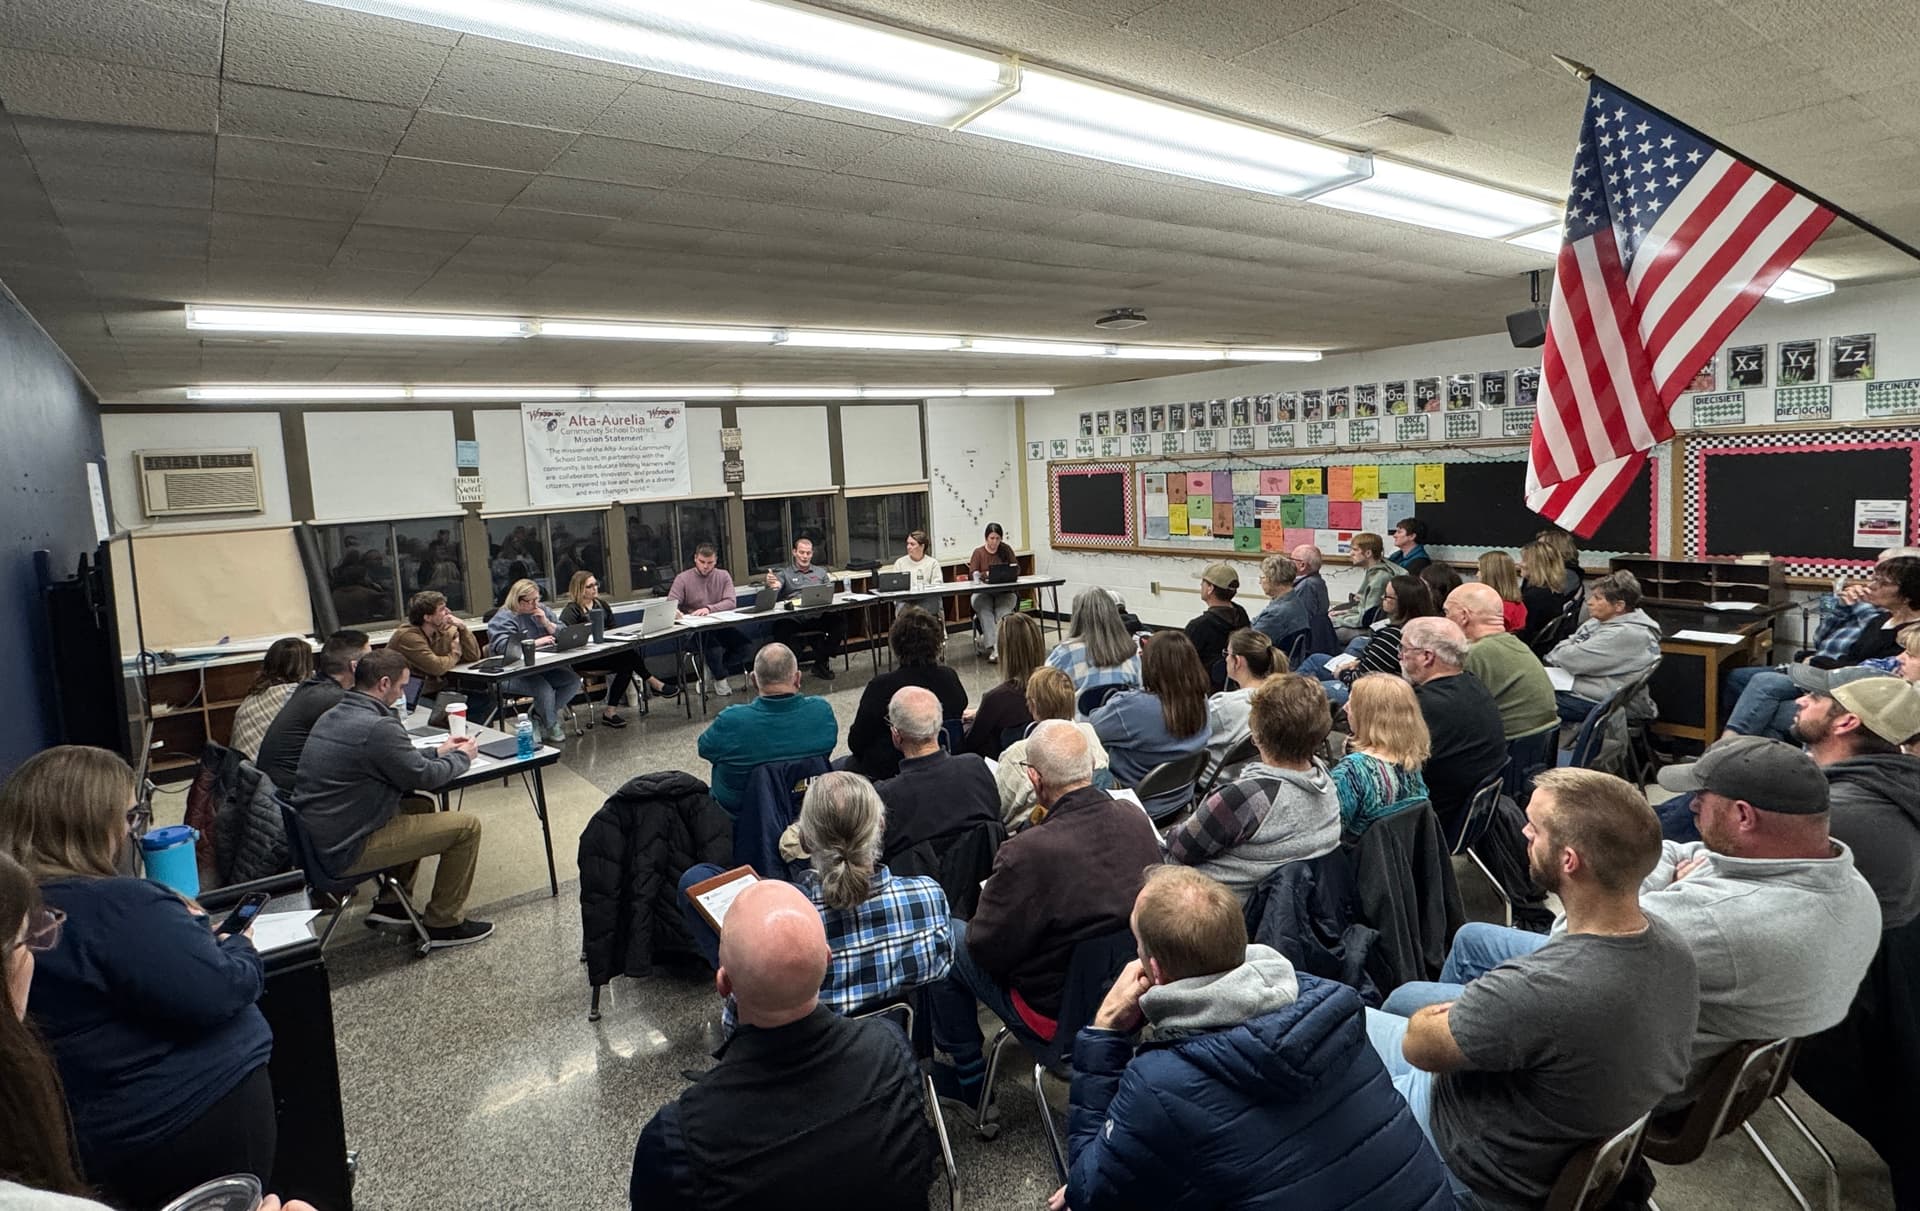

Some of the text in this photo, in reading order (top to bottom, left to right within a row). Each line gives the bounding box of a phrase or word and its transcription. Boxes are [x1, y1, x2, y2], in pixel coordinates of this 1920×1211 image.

[1786, 351, 1811, 369] Yy
[1839, 346, 1866, 363] Zz
[1736, 356, 1759, 372] Xx
[1486, 380, 1502, 393] Rr
[1521, 377, 1538, 390] Ss
[1869, 381, 1920, 391] DIECINUEV
[1387, 390, 1403, 401] Oo
[1419, 386, 1434, 401] Pp
[1452, 384, 1471, 397] Qq
[1328, 393, 1348, 407] Mm
[1696, 394, 1741, 405] DIECISIETE
[1172, 409, 1182, 420] Ff
[1777, 405, 1829, 416] DIECIOCHO
[569, 414, 645, 427] Alta-Aurelia
[1506, 422, 1533, 430] CATORC
[561, 425, 654, 436] Community School District
[575, 434, 643, 443] Mission Statement
